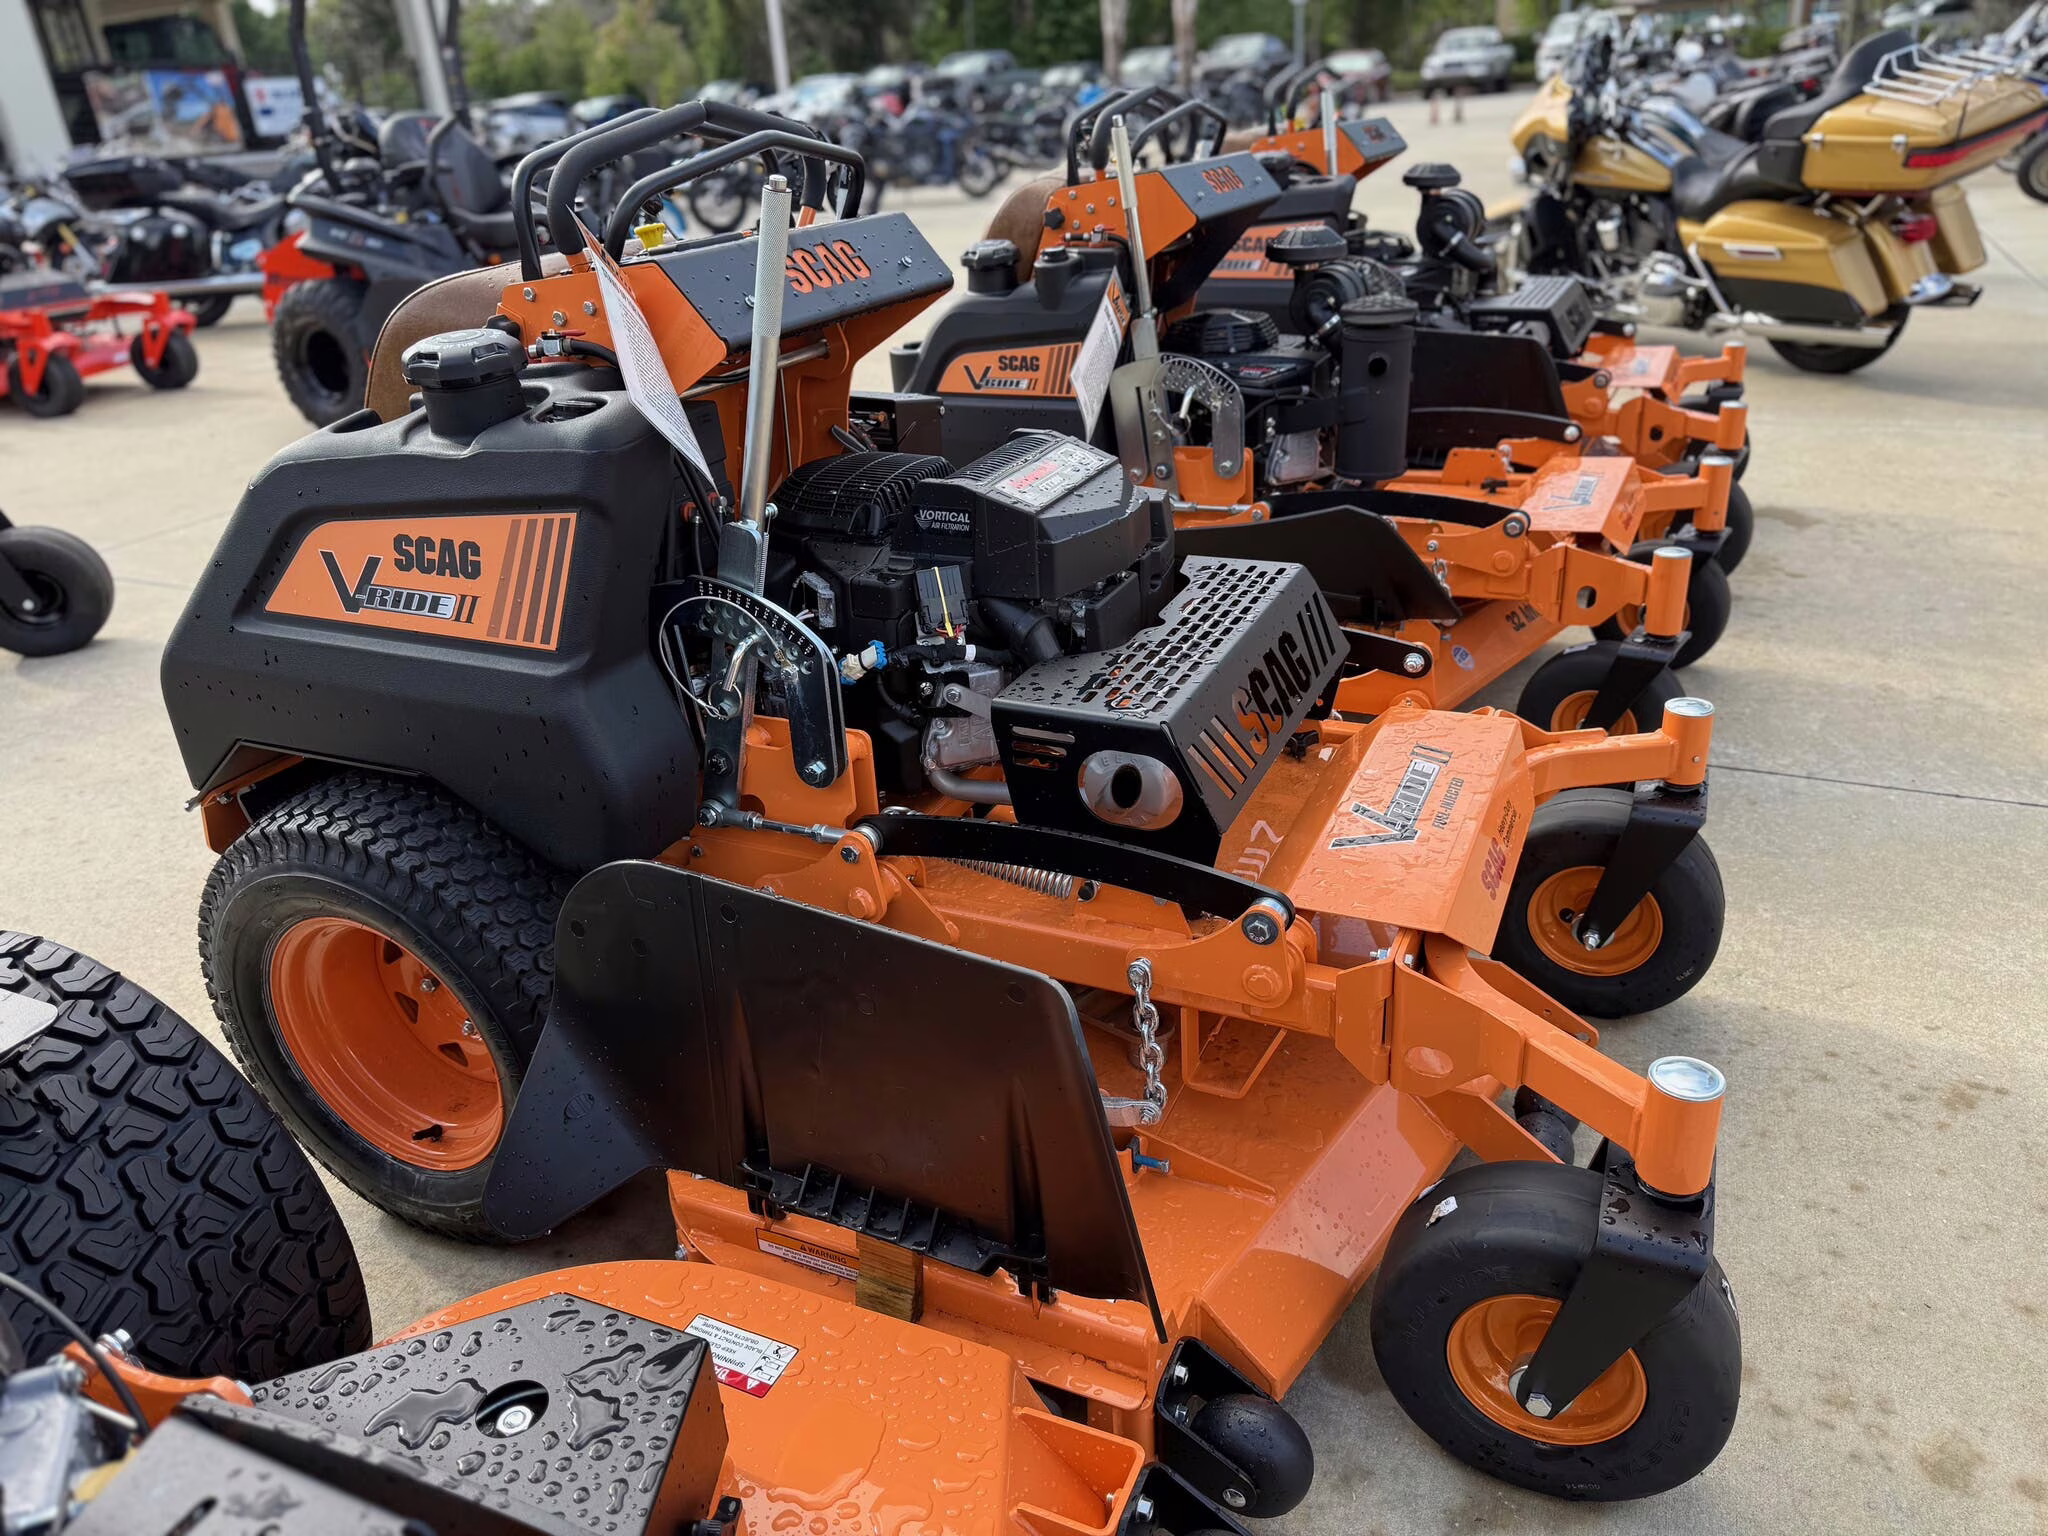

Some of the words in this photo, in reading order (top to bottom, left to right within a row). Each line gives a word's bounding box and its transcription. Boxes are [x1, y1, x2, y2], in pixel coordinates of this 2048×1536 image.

[1201, 165, 1244, 194] SCAG
[786, 239, 872, 294] SCAG
[998, 355, 1040, 372] SCAG
[919, 510, 970, 523] VORTICAL
[941, 522, 970, 531] FILTRATION
[392, 533, 482, 580] SCAG
[1232, 630, 1312, 756] SCAG
[1431, 776, 1465, 830] FUEL-INJECTED
[1481, 836, 1507, 901] SCAG
[807, 1246, 847, 1264] WARNING
[689, 1324, 713, 1336] THROWN
[701, 1321, 721, 1332] INJURE
[722, 1328, 733, 1336] CAN
[717, 1334, 743, 1347] CONTACT
[733, 1332, 759, 1344] OBJECTS
[721, 1345, 736, 1354] KEEP
[744, 1344, 762, 1353] BLADE
